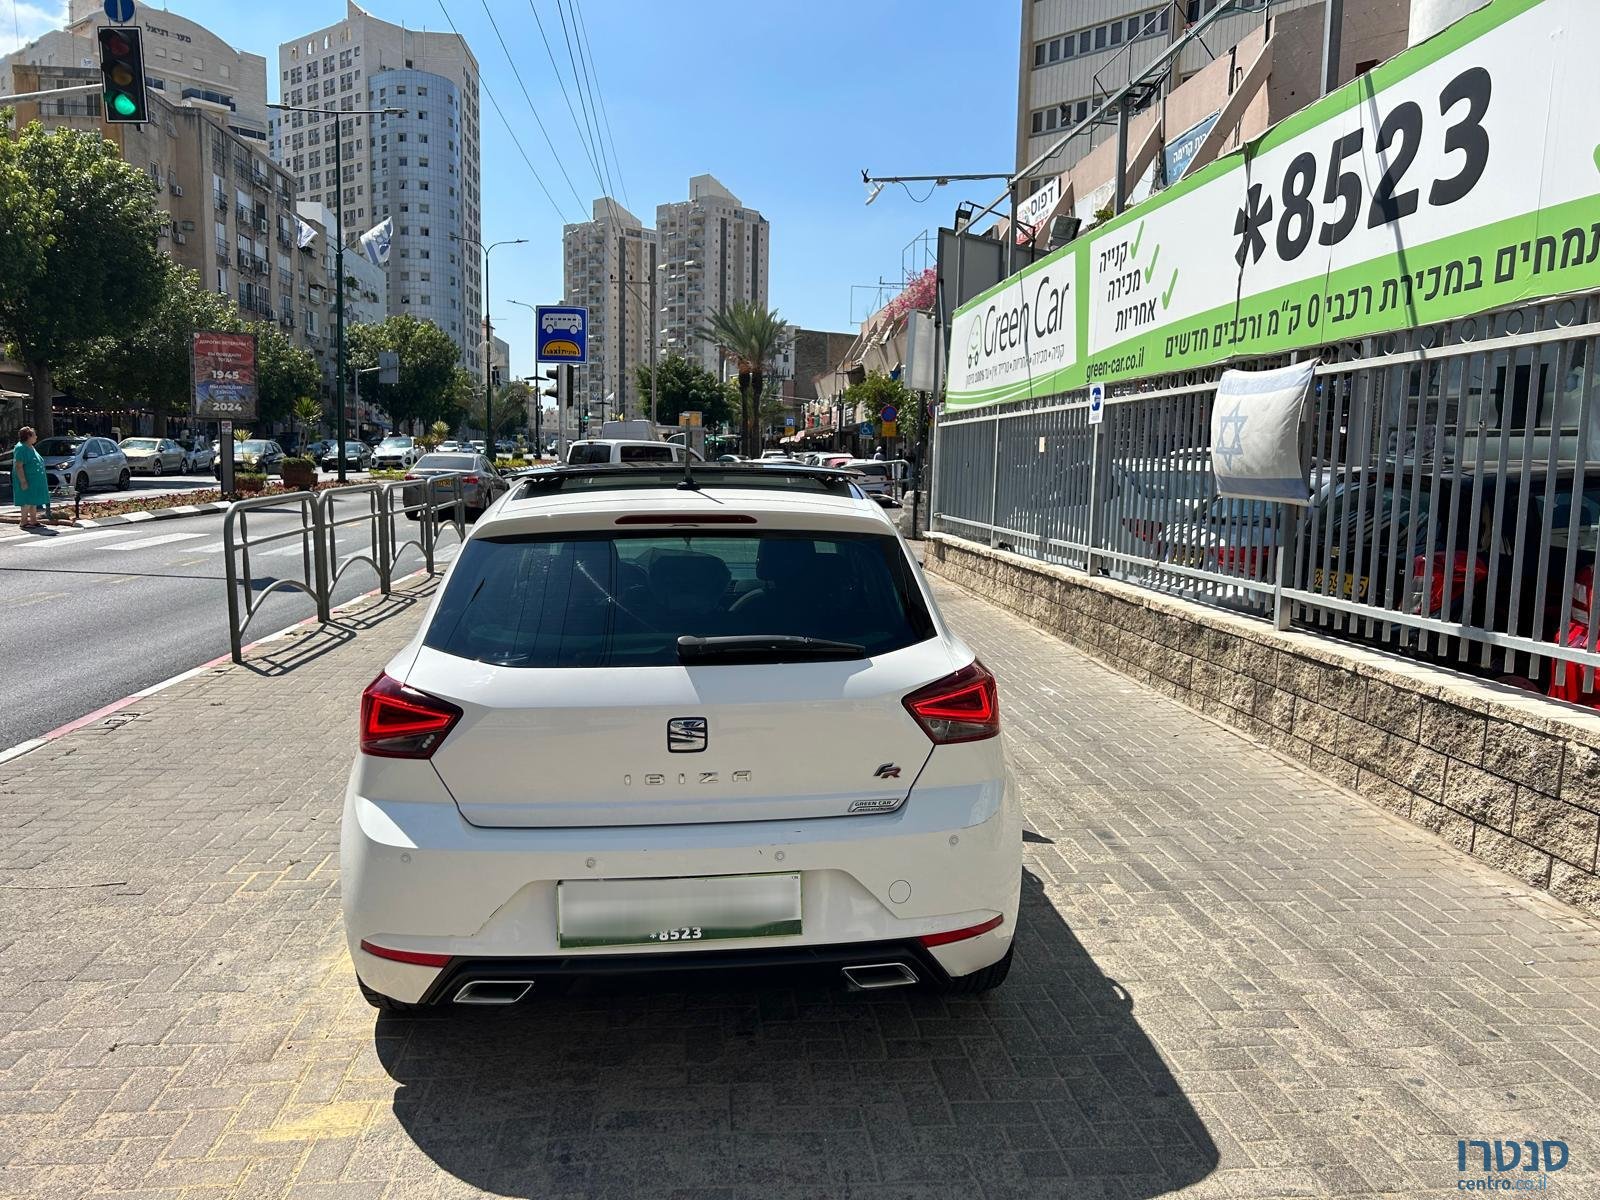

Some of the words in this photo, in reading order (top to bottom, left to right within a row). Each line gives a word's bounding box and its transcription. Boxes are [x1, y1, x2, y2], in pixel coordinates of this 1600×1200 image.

[1031, 186, 1054, 216] דפוס
[1099, 241, 1128, 273] קנייה
[1107, 269, 1141, 302] מכירה
[1379, 255, 1483, 312] במכירת
[984, 304, 1030, 357] Green
[1034, 276, 1070, 338] Car
[1115, 297, 1157, 332] אחריות
[1326, 285, 1373, 323] רכבי
[1165, 327, 1208, 358] חדשים
[1213, 314, 1262, 348] ורכבים
[211, 370, 240, 380] 1945
[1086, 346, 1145, 382] green-car.co.il
[213, 402, 242, 412] 2024
[624, 770, 752, 786] IBIZA
